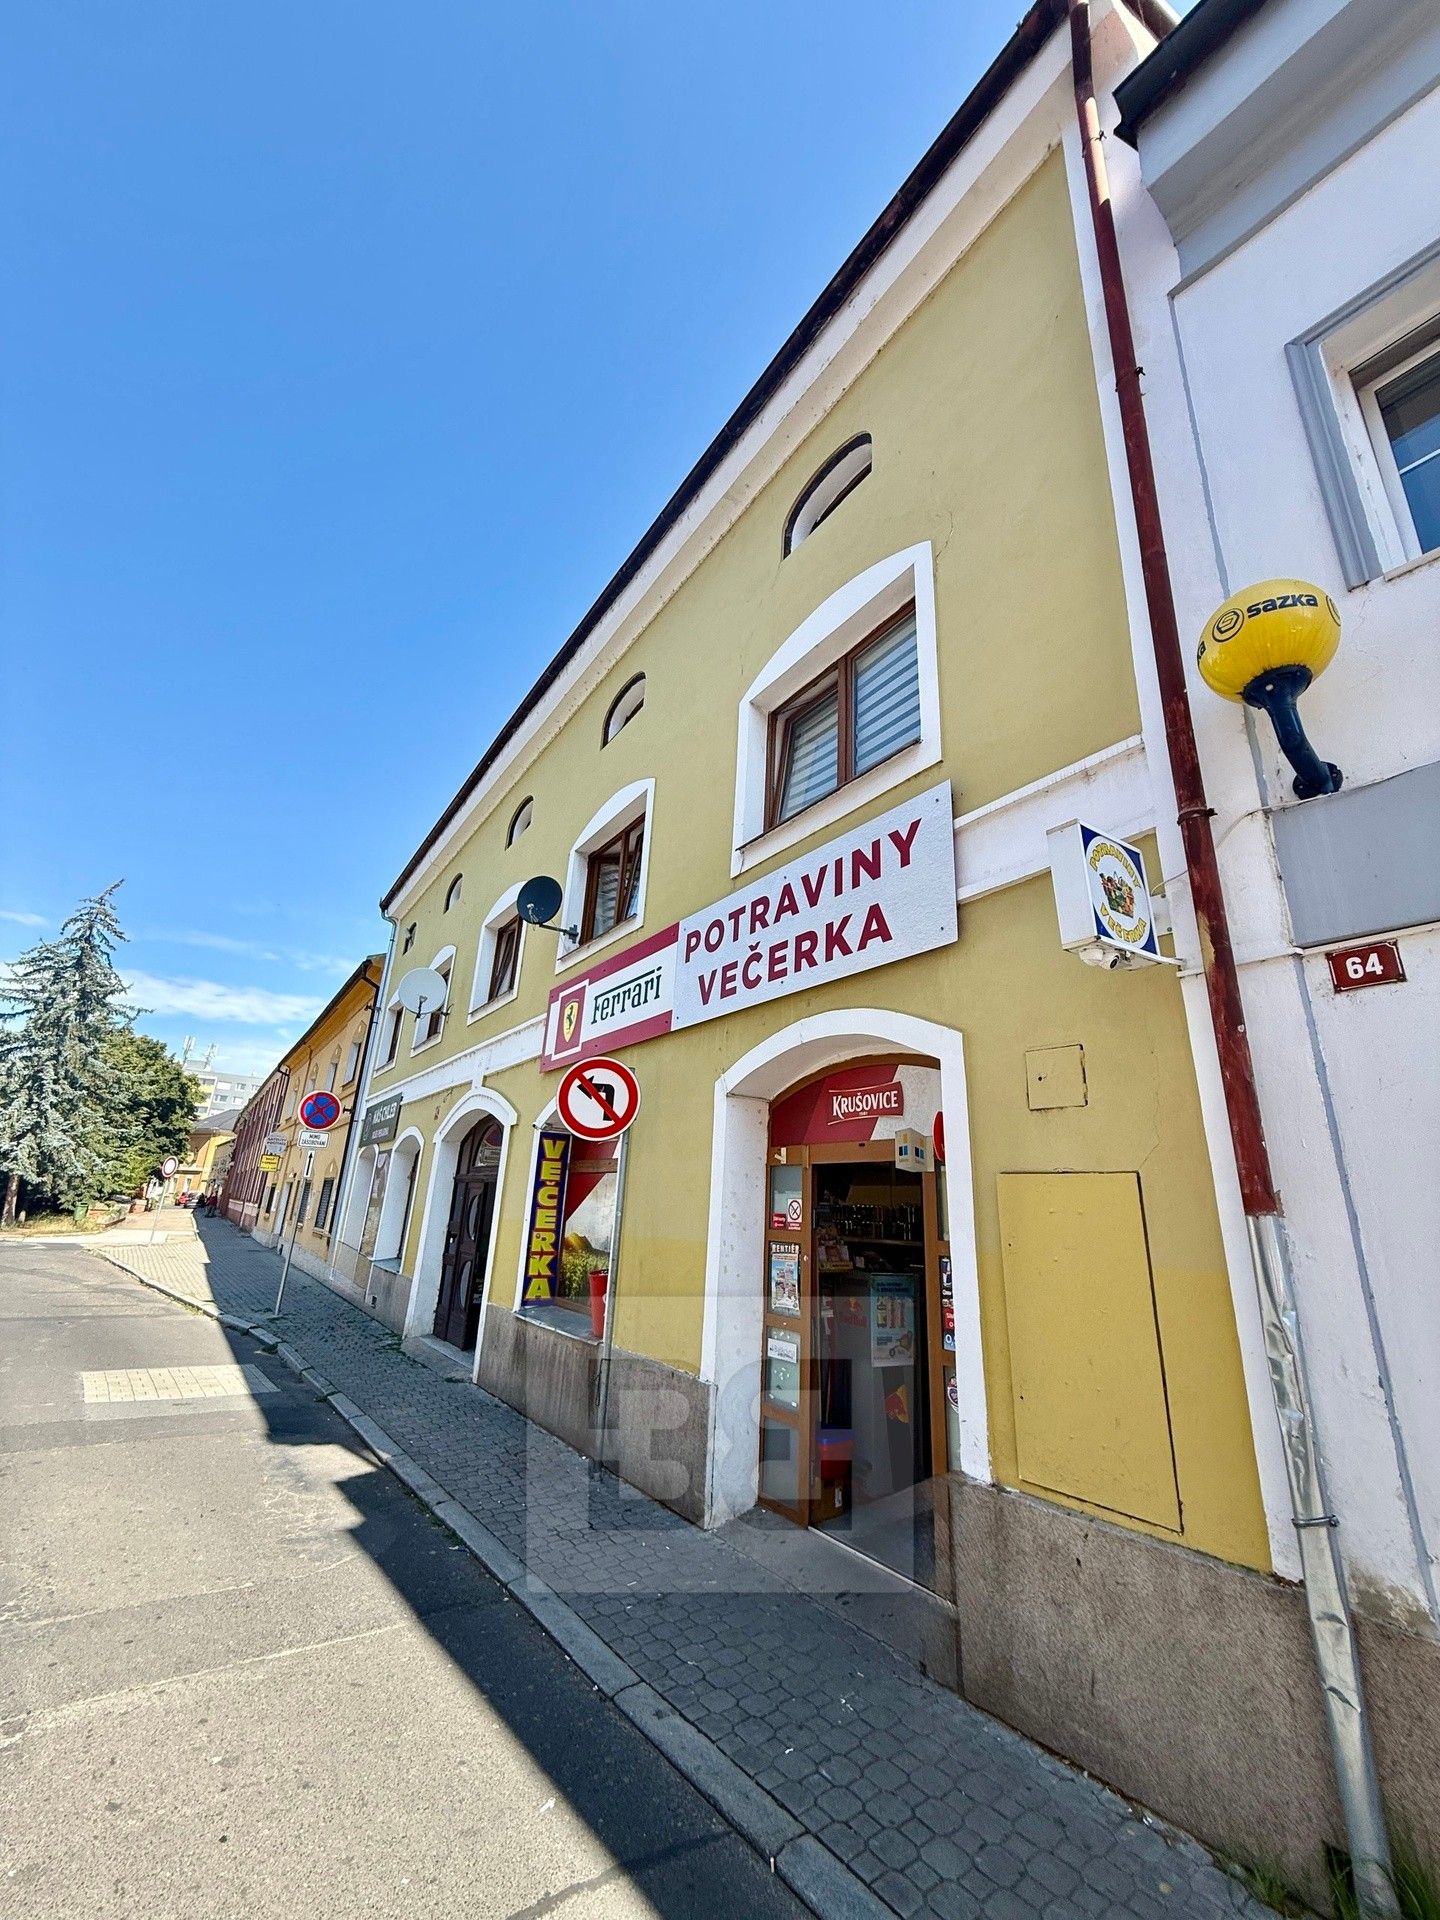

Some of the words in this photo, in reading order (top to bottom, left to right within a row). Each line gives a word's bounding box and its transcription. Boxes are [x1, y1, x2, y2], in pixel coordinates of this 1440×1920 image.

[1246, 593, 1319, 619] sazka
[684, 817, 922, 964] POTRAVINY
[1090, 842, 1142, 889] POTRAVINY
[698, 902, 893, 1006] VEČERKA
[1345, 952, 1384, 980] 64
[591, 966, 662, 1025] Ferrari
[832, 1090, 899, 1120] KRUŠOVICE
[525, 1138, 566, 1300] VEČERKA
